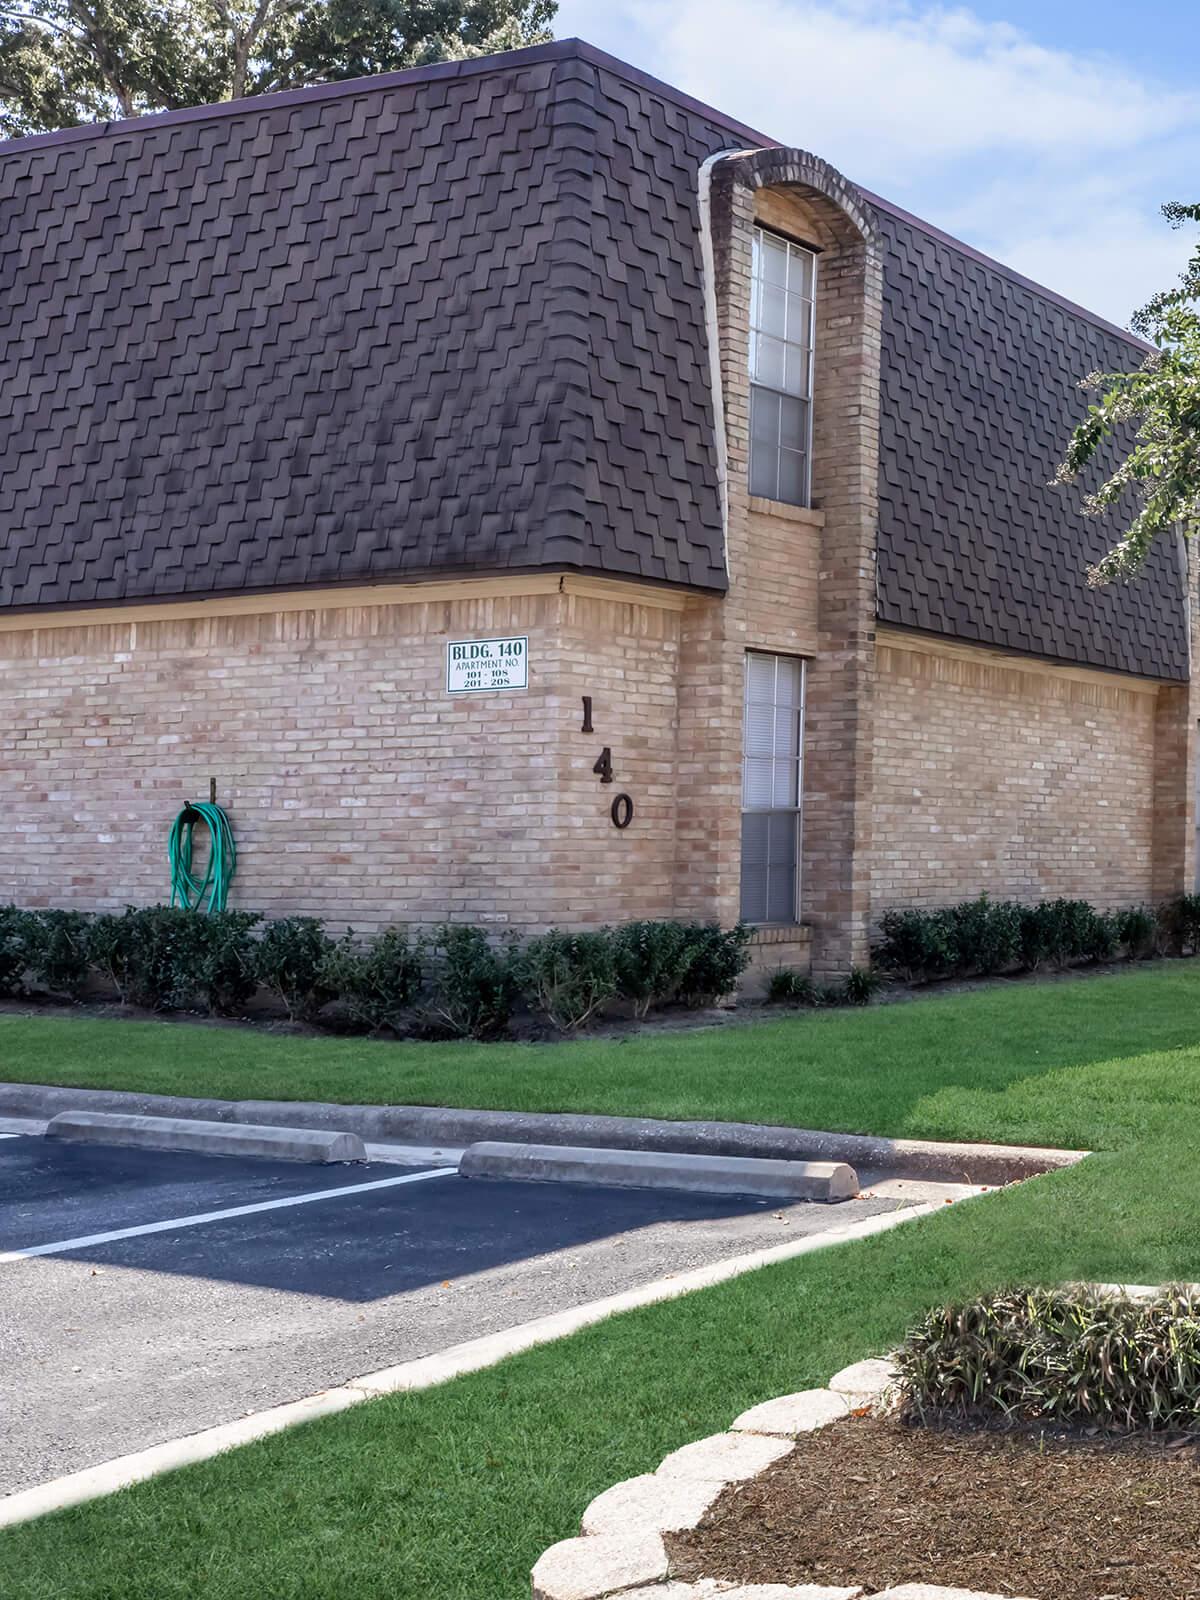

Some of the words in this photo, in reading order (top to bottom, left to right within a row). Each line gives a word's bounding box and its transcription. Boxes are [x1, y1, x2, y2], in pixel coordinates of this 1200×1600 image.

[453, 644, 493, 660] BLDG.
[498, 642, 522, 656] 140
[456, 660, 502, 671] APARTMENT
[467, 671, 481, 679] 101
[464, 680, 481, 688] 201
